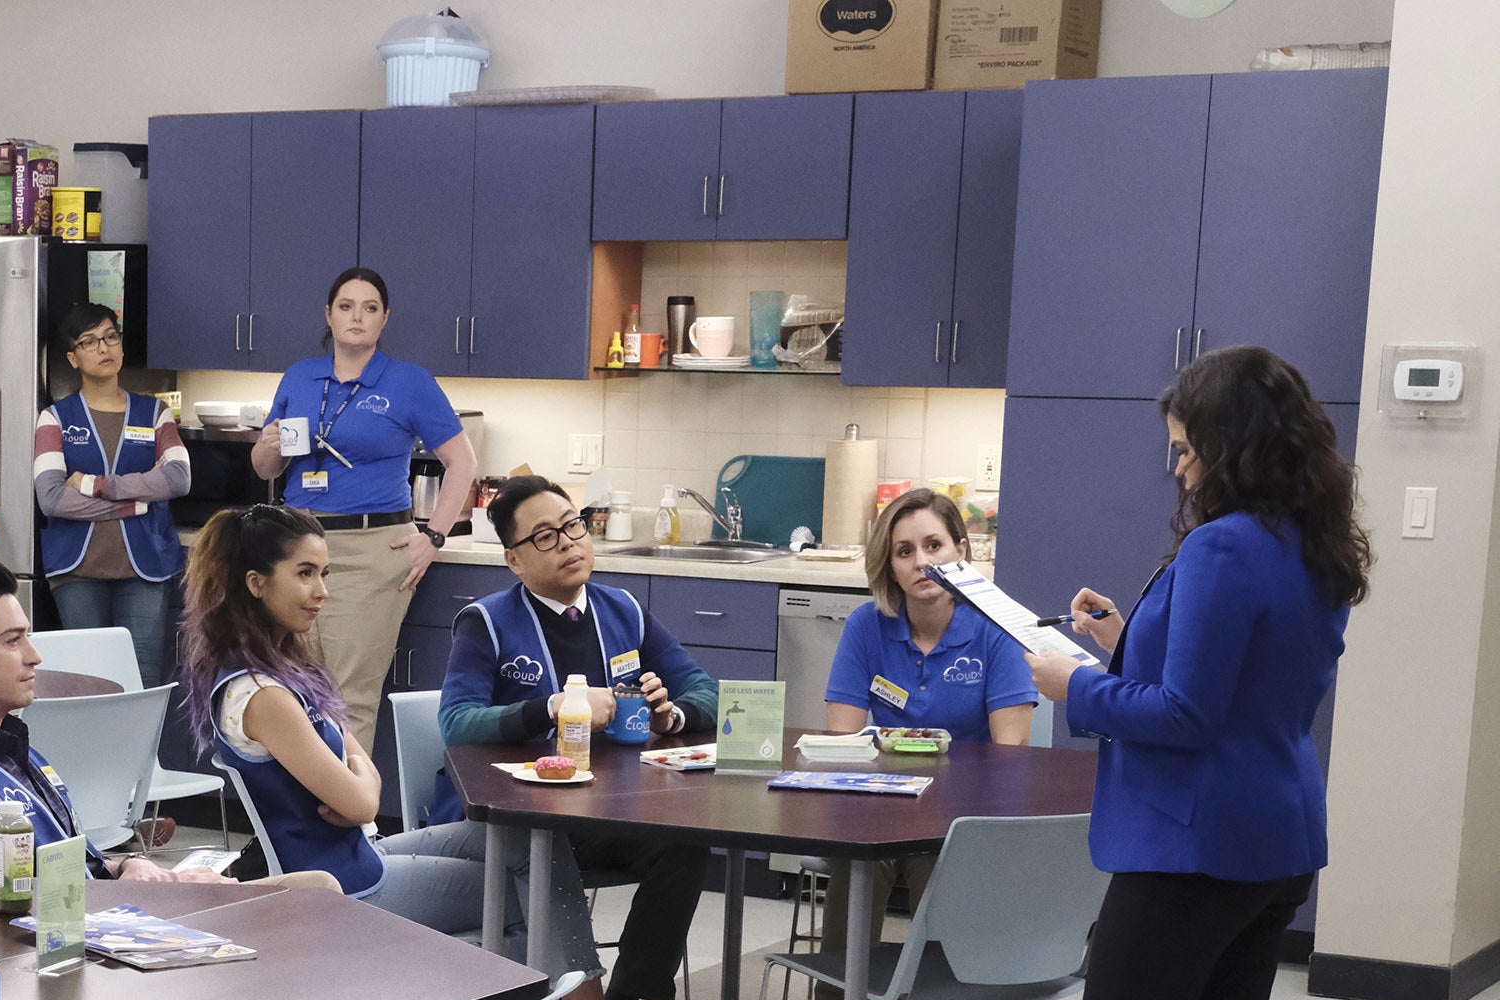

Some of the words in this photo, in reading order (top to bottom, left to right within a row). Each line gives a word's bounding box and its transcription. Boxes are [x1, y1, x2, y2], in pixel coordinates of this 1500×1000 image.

[837, 10, 876, 20] Waters
[15, 165, 25, 195] Raisin
[32, 170, 56, 188] Raisin
[38, 185, 52, 198] Bra
[15, 197, 25, 220] Bran
[616, 662, 638, 674] MATEO
[500, 669, 542, 682] CLOUD9
[944, 672, 983, 682] CLOUD9
[875, 686, 901, 704] ASHLEY
